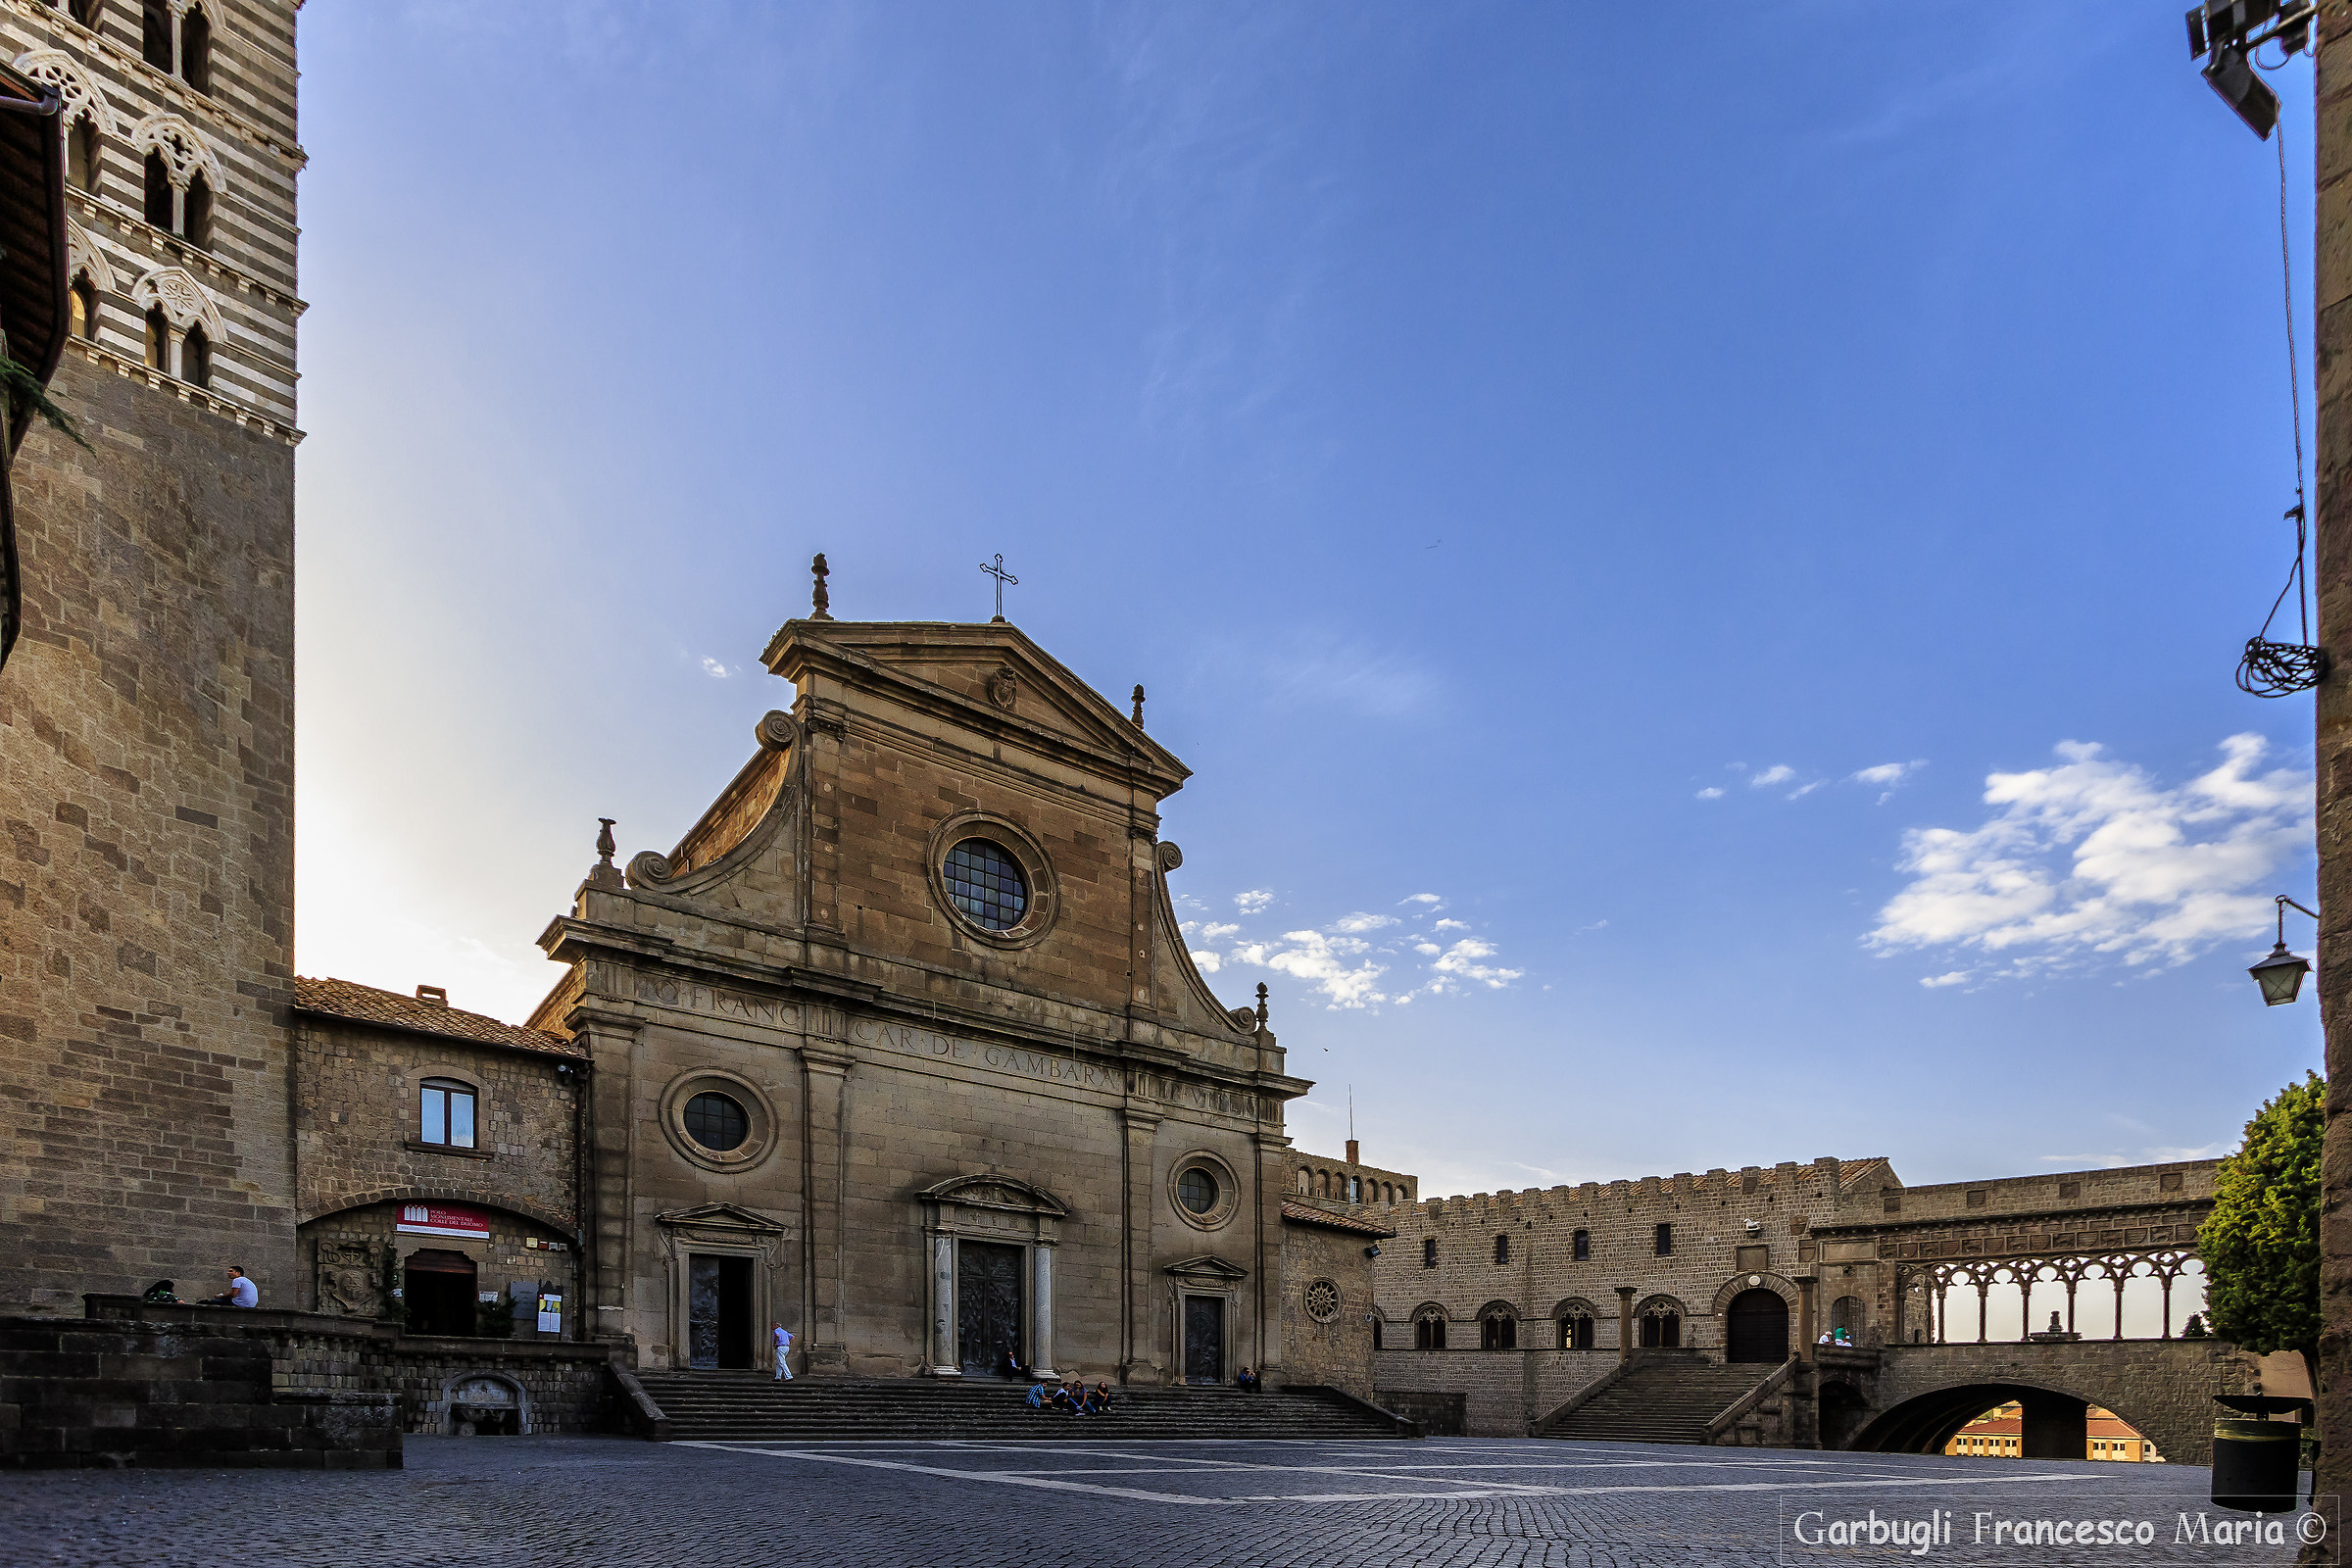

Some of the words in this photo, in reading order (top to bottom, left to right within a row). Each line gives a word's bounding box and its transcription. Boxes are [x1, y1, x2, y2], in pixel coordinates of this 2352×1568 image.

[855, 1021, 915, 1051] CAR
[932, 1035, 965, 1059] DE
[985, 1046, 1118, 1090] GAMBARA
